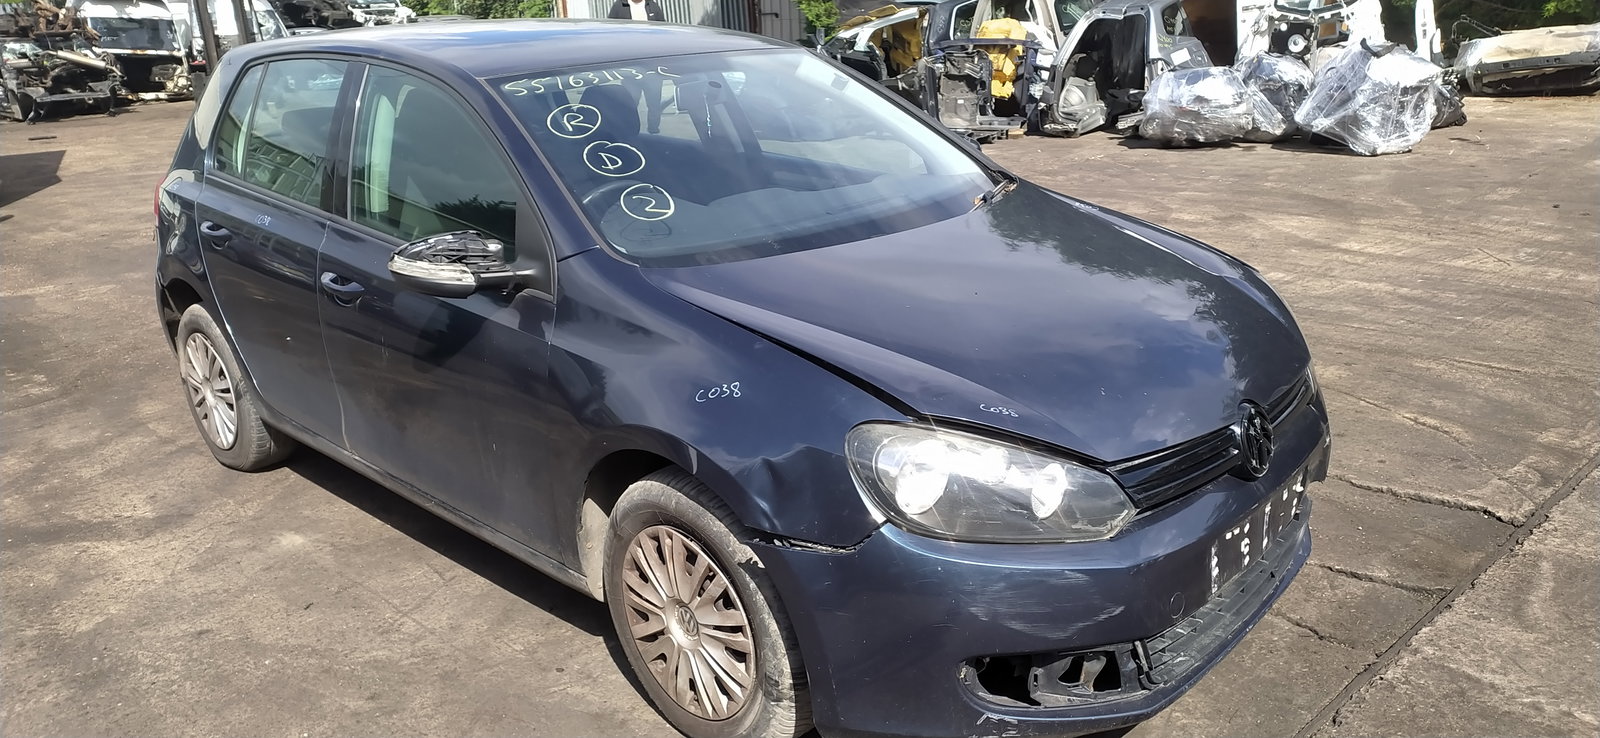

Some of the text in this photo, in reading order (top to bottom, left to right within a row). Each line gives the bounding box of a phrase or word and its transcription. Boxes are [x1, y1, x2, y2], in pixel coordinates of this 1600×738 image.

[563, 112, 595, 132] R
[598, 152, 623, 170] D
[695, 381, 741, 402] C038
